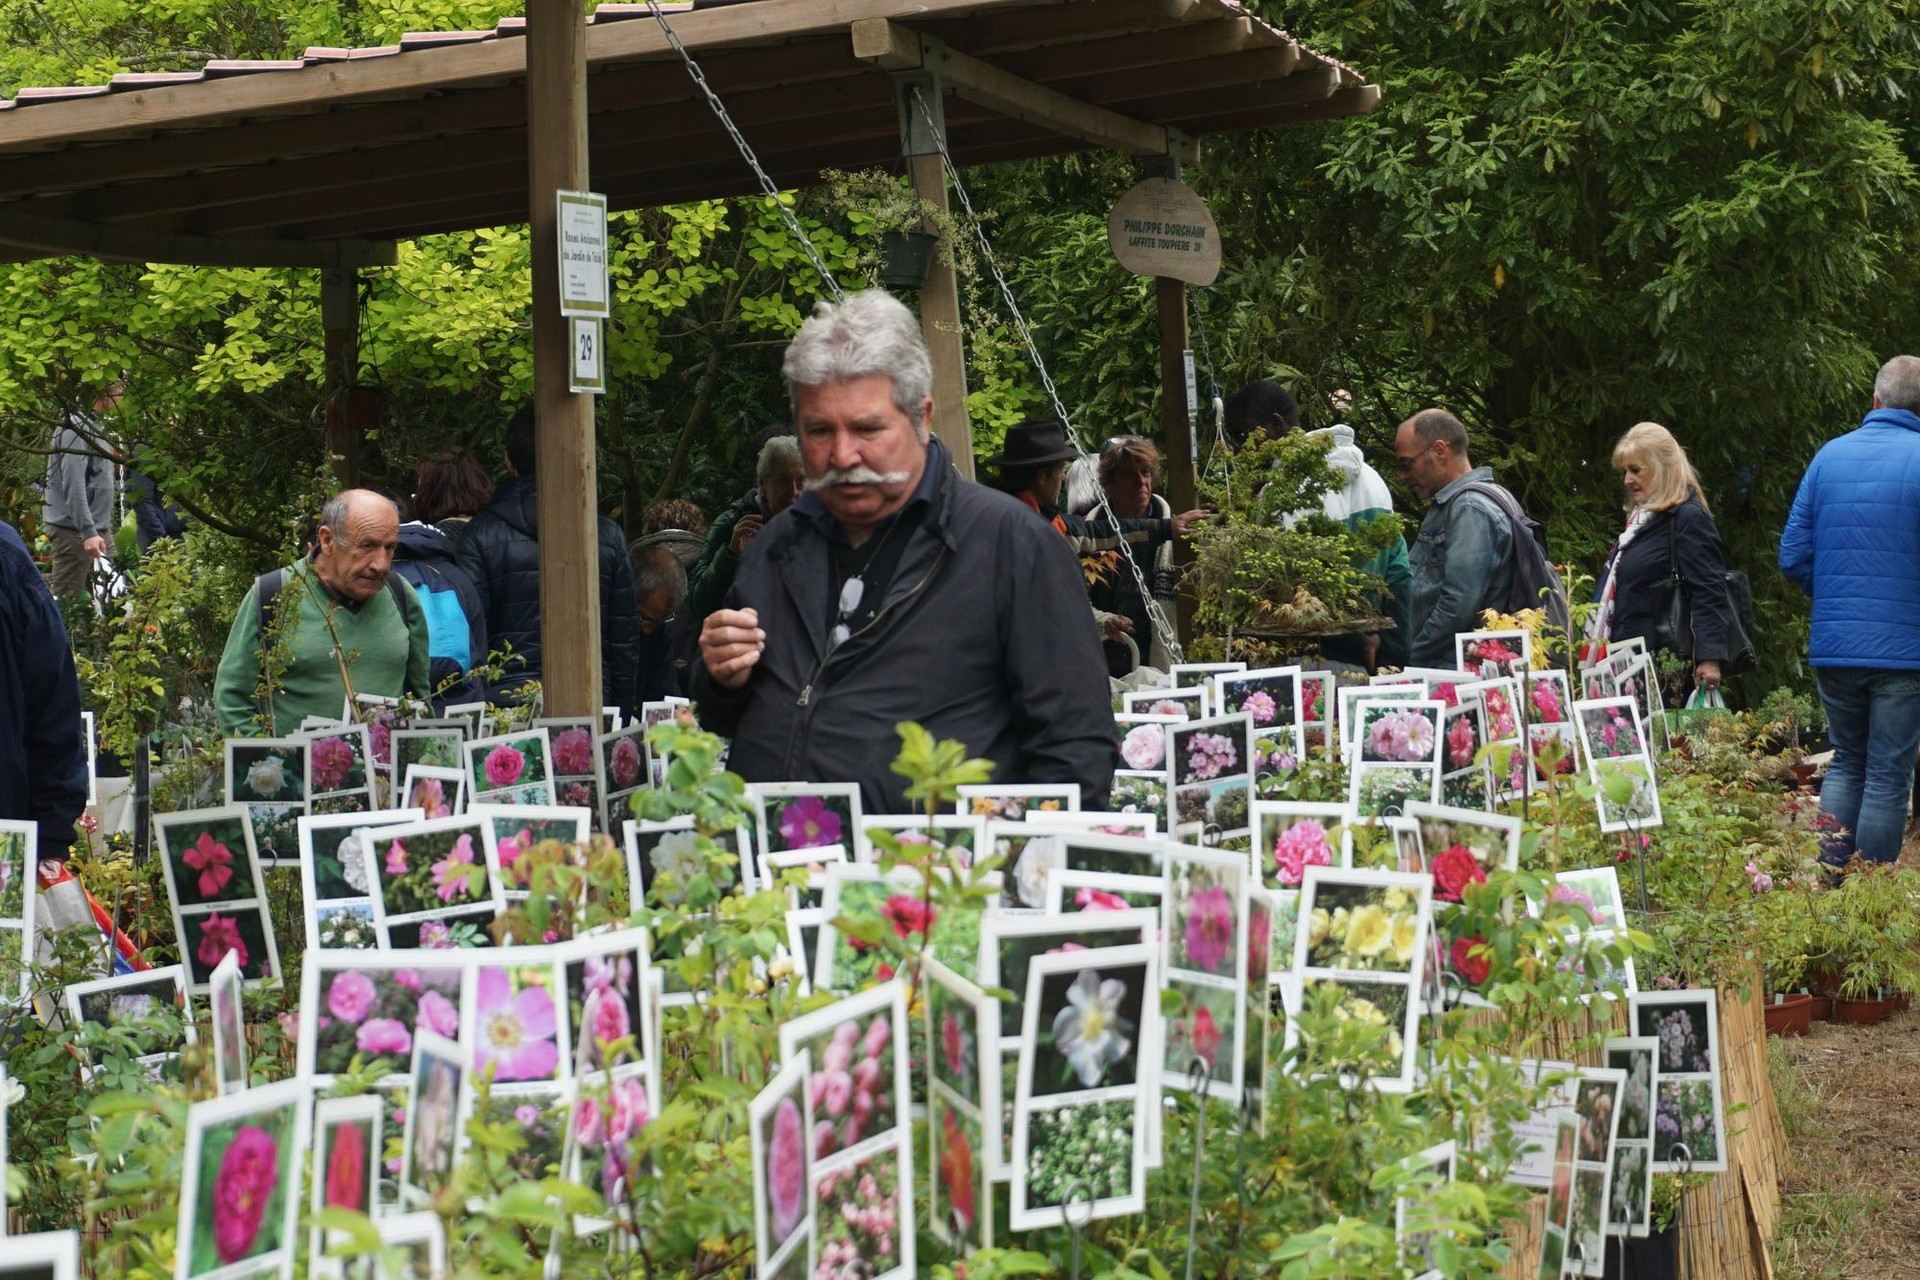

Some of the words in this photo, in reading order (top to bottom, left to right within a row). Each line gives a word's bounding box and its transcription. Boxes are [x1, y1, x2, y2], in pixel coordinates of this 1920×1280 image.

[1124, 219, 1162, 235] PHILIPPE
[1128, 236, 1156, 249] LAFFITE
[580, 333, 592, 361] 29
